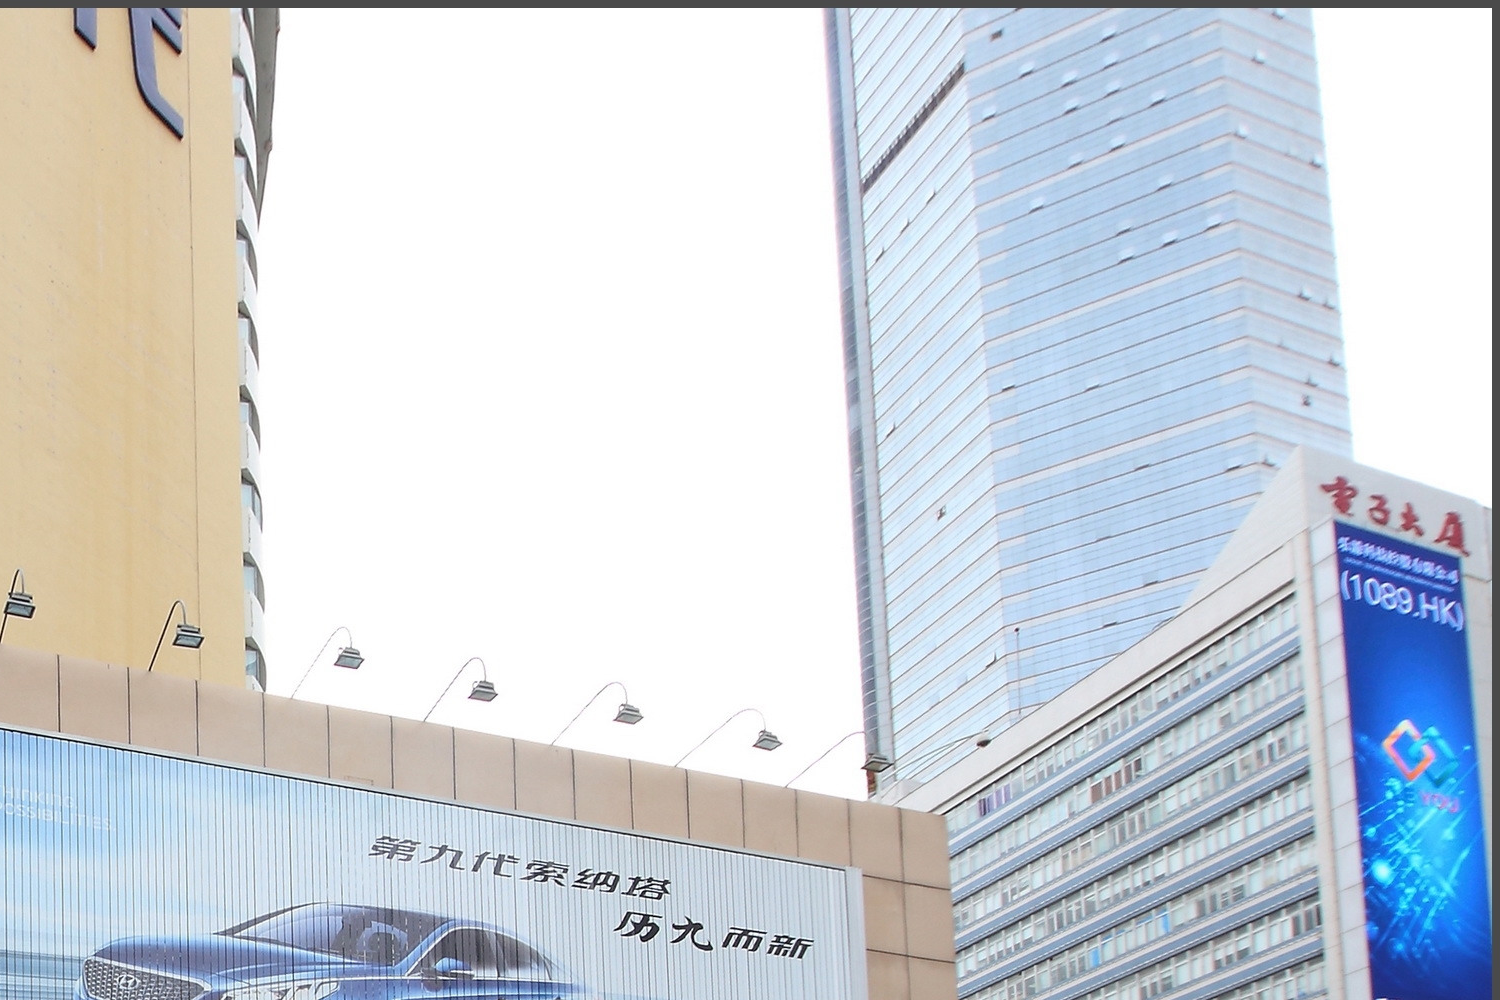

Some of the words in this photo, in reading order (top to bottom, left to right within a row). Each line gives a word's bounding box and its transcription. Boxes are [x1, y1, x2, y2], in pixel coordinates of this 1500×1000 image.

[1340, 570, 1464, 632] (1089.HK)
[369, 835, 671, 901] 第九代索纳塔
[614, 911, 815, 960] 历九而新
